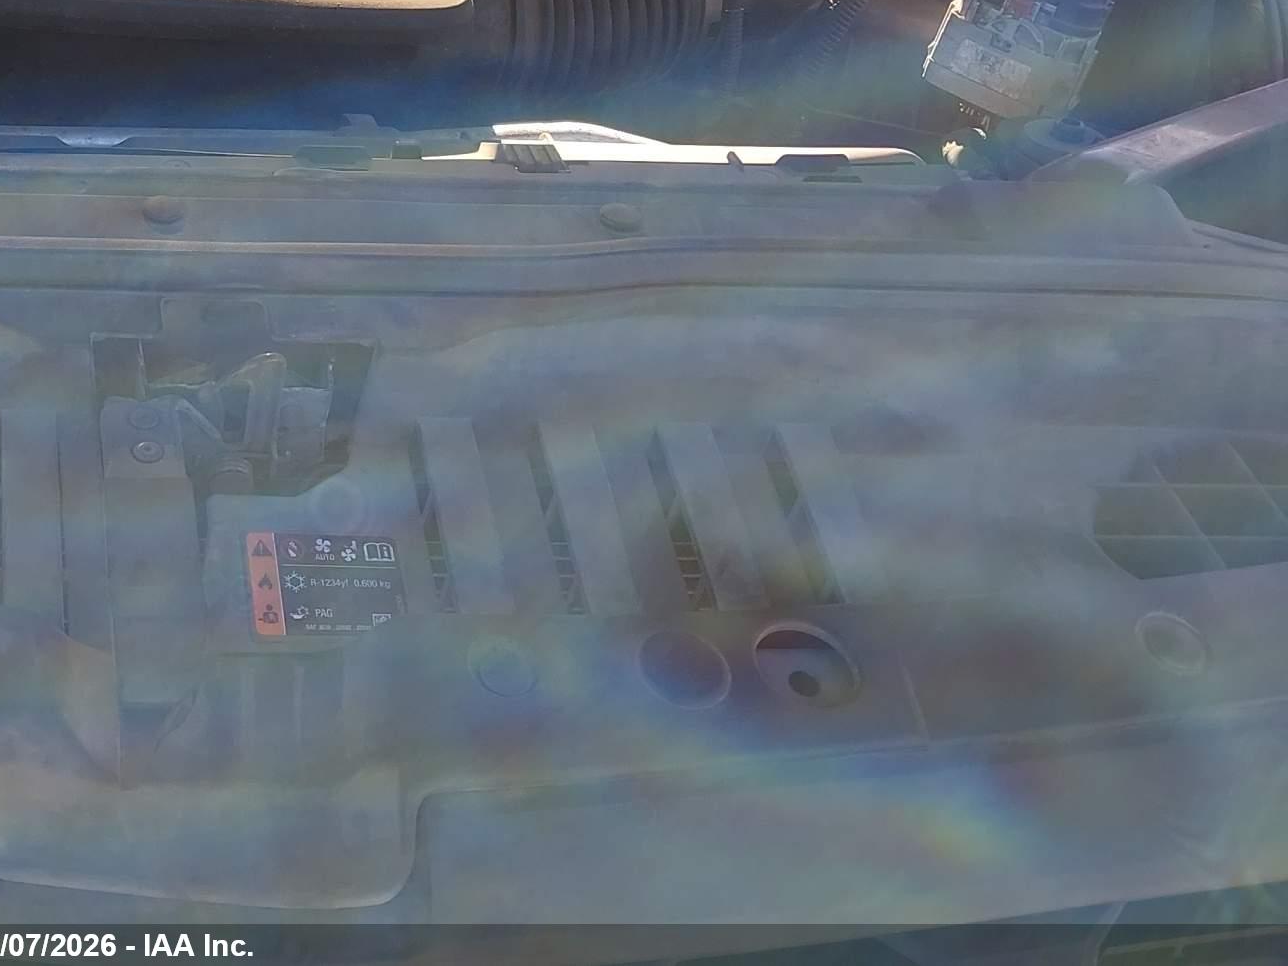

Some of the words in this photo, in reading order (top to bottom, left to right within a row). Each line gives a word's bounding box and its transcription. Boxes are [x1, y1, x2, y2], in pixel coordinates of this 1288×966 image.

[315, 553, 335, 561] AUTO
[353, 577, 378, 588] 0.600
[379, 579, 391, 590] kg
[315, 608, 333, 618] PAG
